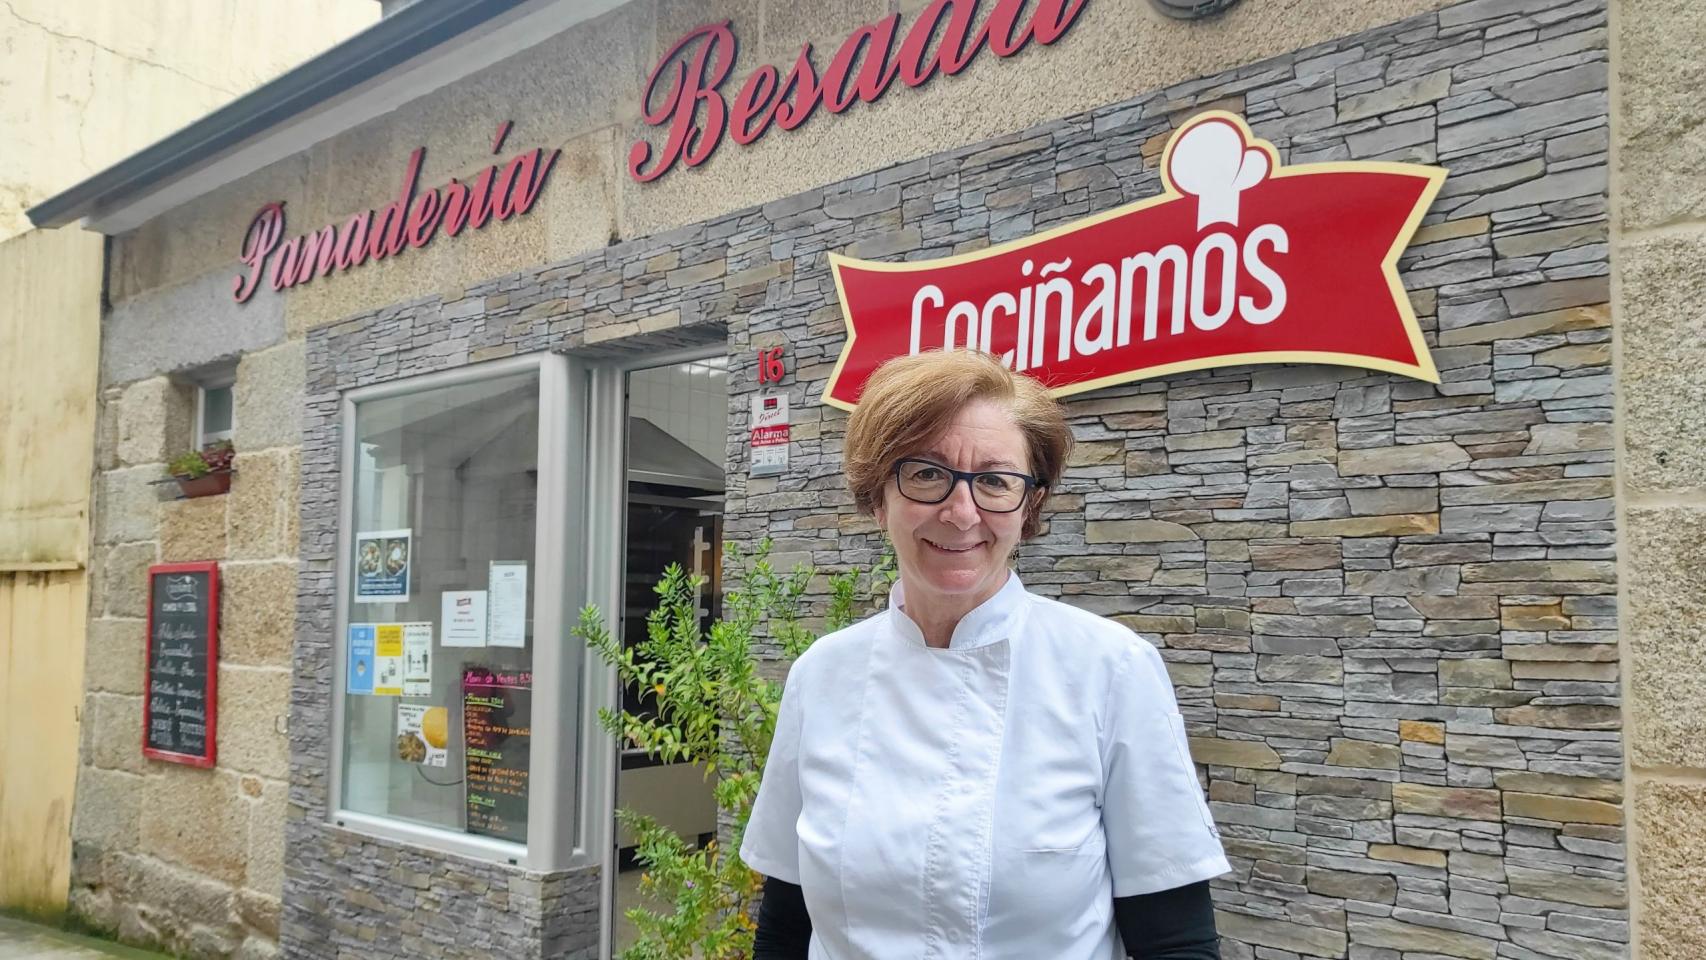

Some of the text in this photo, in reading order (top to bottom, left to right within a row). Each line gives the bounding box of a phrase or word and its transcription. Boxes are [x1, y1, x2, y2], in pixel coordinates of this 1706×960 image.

[232, 0, 1088, 304] Panadería Besada
[909, 222, 1289, 372] Cociñamos
[758, 346, 785, 385] 16
[752, 428, 789, 441] Alarma
